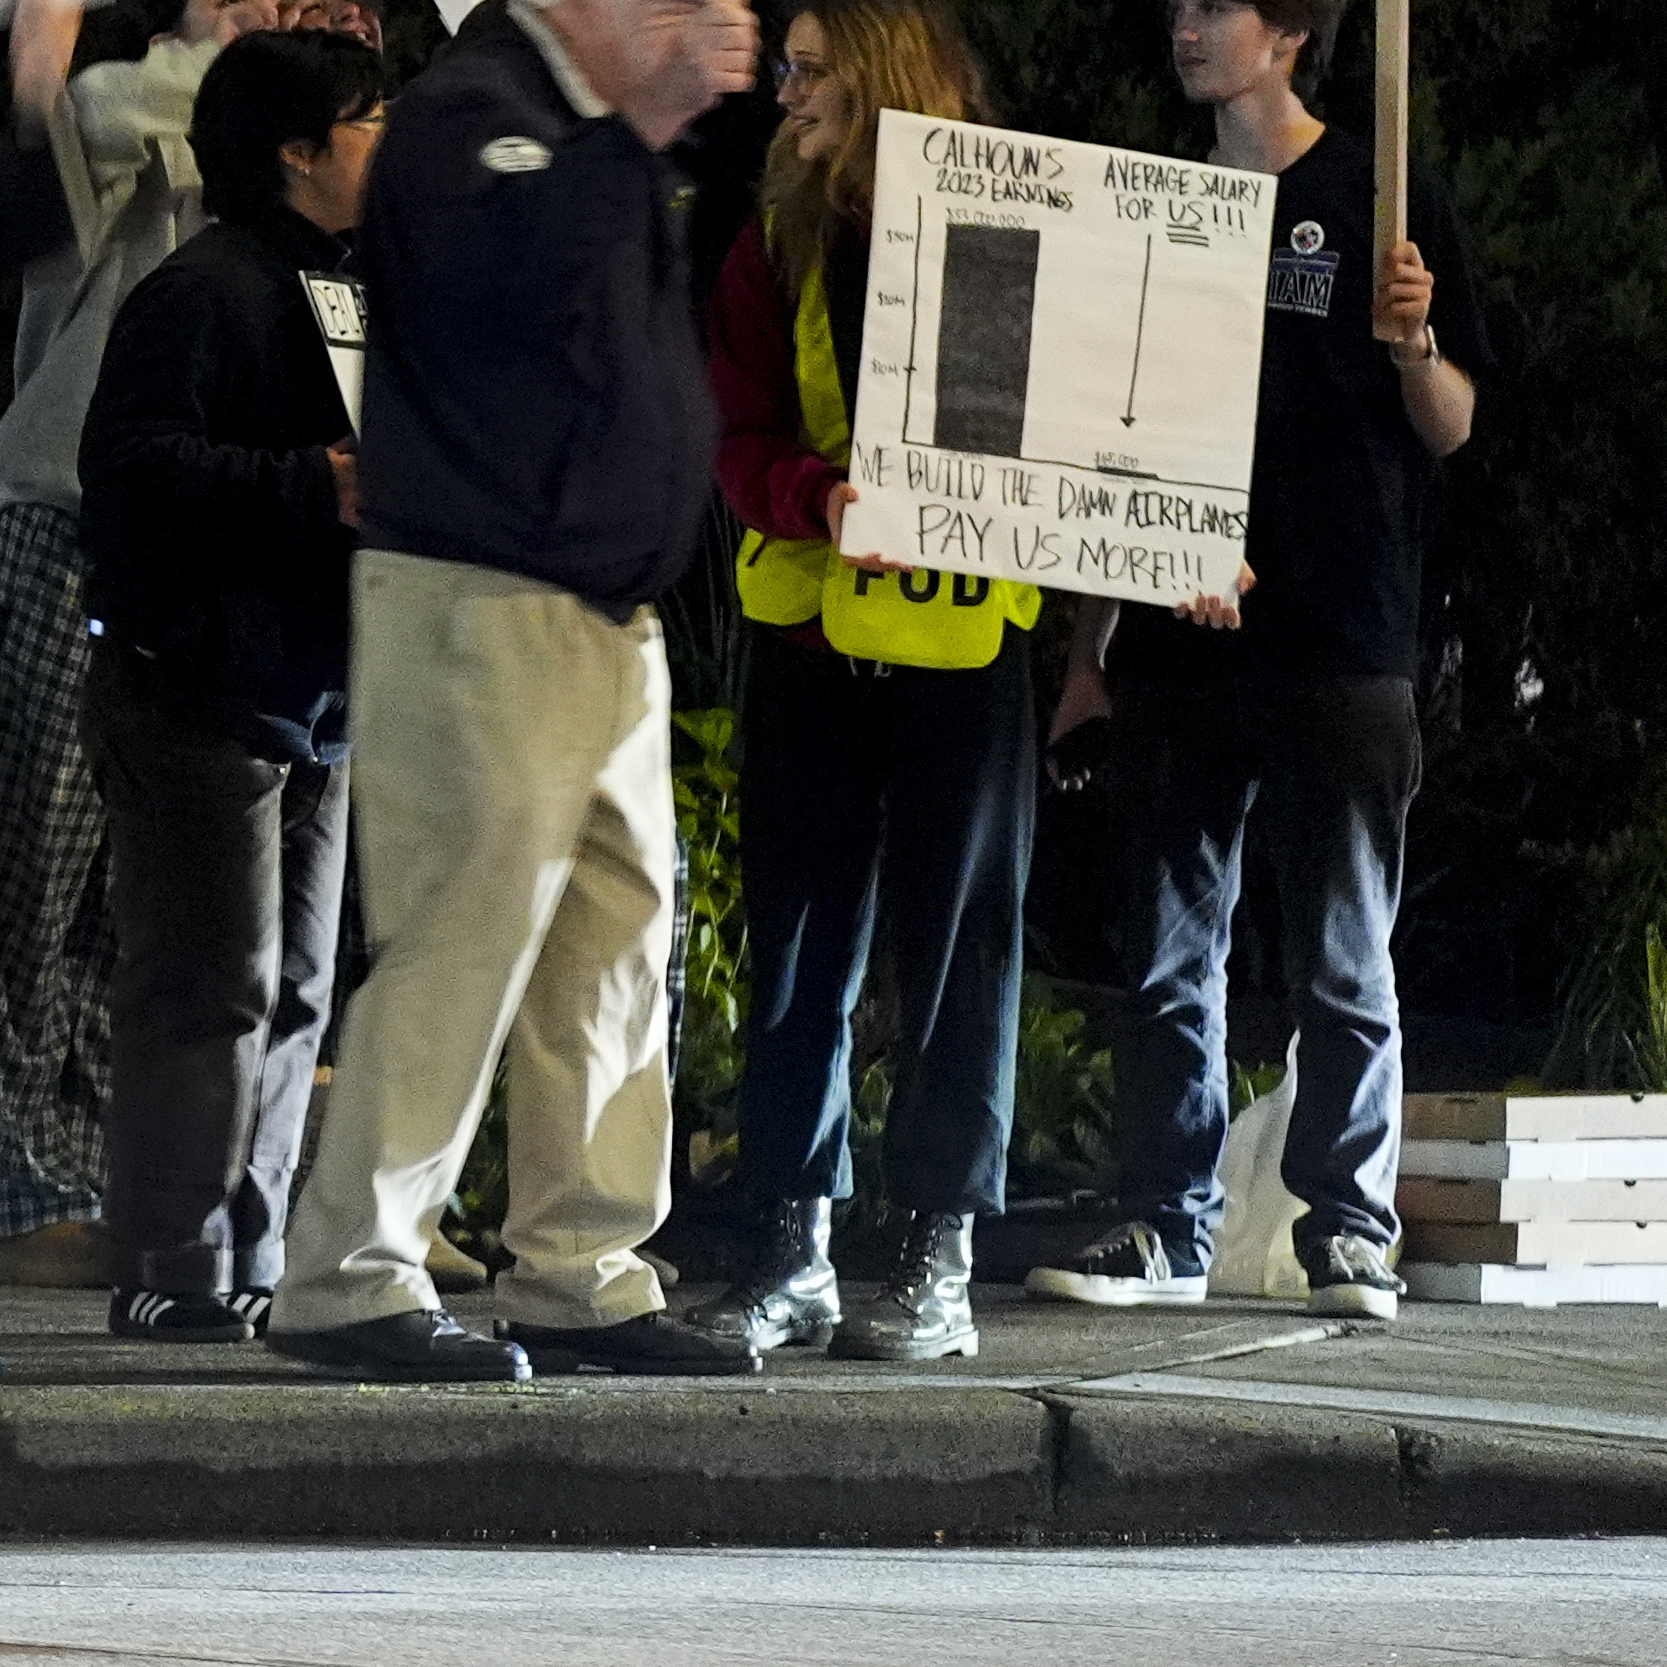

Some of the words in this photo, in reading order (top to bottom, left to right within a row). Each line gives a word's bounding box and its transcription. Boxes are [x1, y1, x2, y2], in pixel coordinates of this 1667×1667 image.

[936, 167, 986, 199] 2023
[990, 177, 1074, 213] EARNINGS
[1104, 152, 1191, 196] AVERAGE
[1199, 171, 1262, 209] SALARY
[1115, 194, 1156, 221] FOR
[855, 440, 893, 487] WE
[906, 448, 985, 502] BUILD
[999, 465, 1043, 507] THE
[1058, 475, 1116, 520] DAMN
[1124, 488, 1249, 540] AIRPLANES
[915, 503, 994, 562] PAY
[1013, 524, 1062, 571] US
